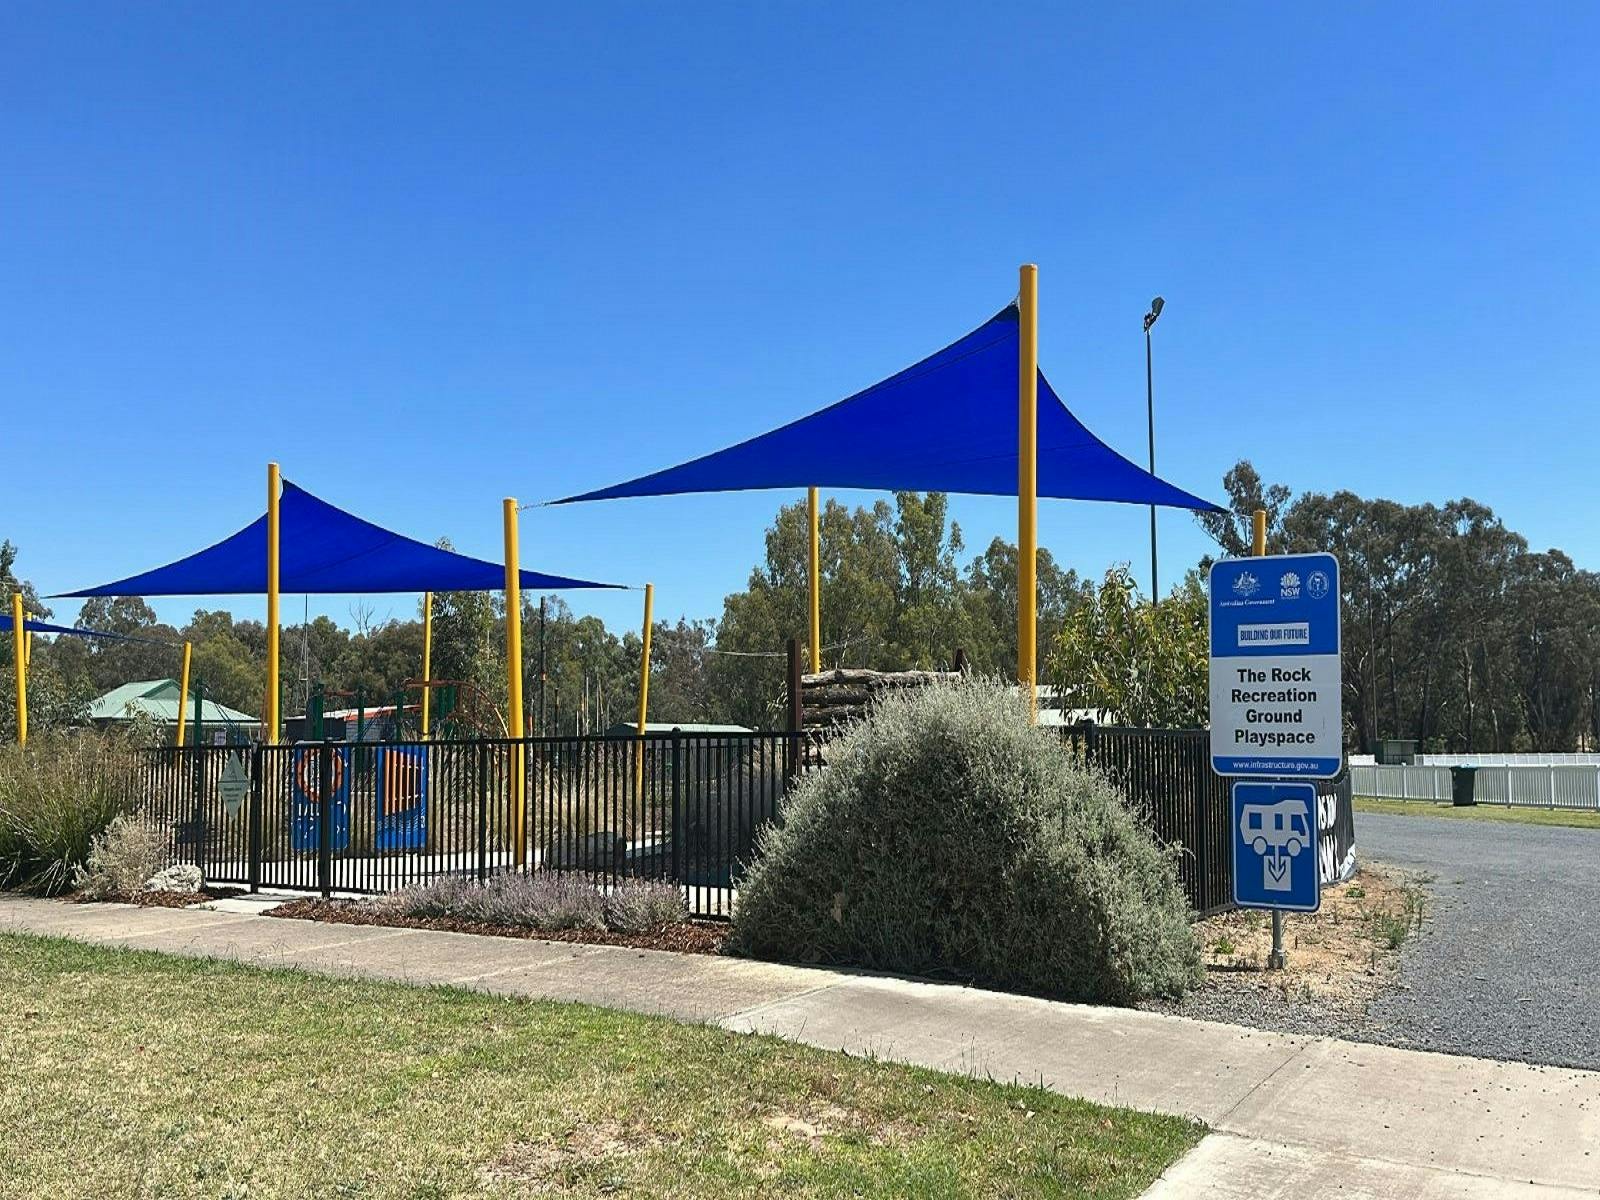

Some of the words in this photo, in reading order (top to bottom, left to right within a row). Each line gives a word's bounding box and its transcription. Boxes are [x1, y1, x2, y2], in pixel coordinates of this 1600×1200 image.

[1280, 587, 1300, 597] NSW
[1240, 630, 1268, 641] BUILDING
[1270, 629, 1282, 640] OUR
[1284, 628, 1307, 640] FUTURE
[1237, 669, 1266, 683] The
[1271, 668, 1311, 682] Rock
[1231, 688, 1317, 703] Recreation
[1246, 709, 1302, 723] Ground
[1235, 729, 1315, 747] Playspace
[1232, 761, 1319, 771] www.infrastructure.gov.au
